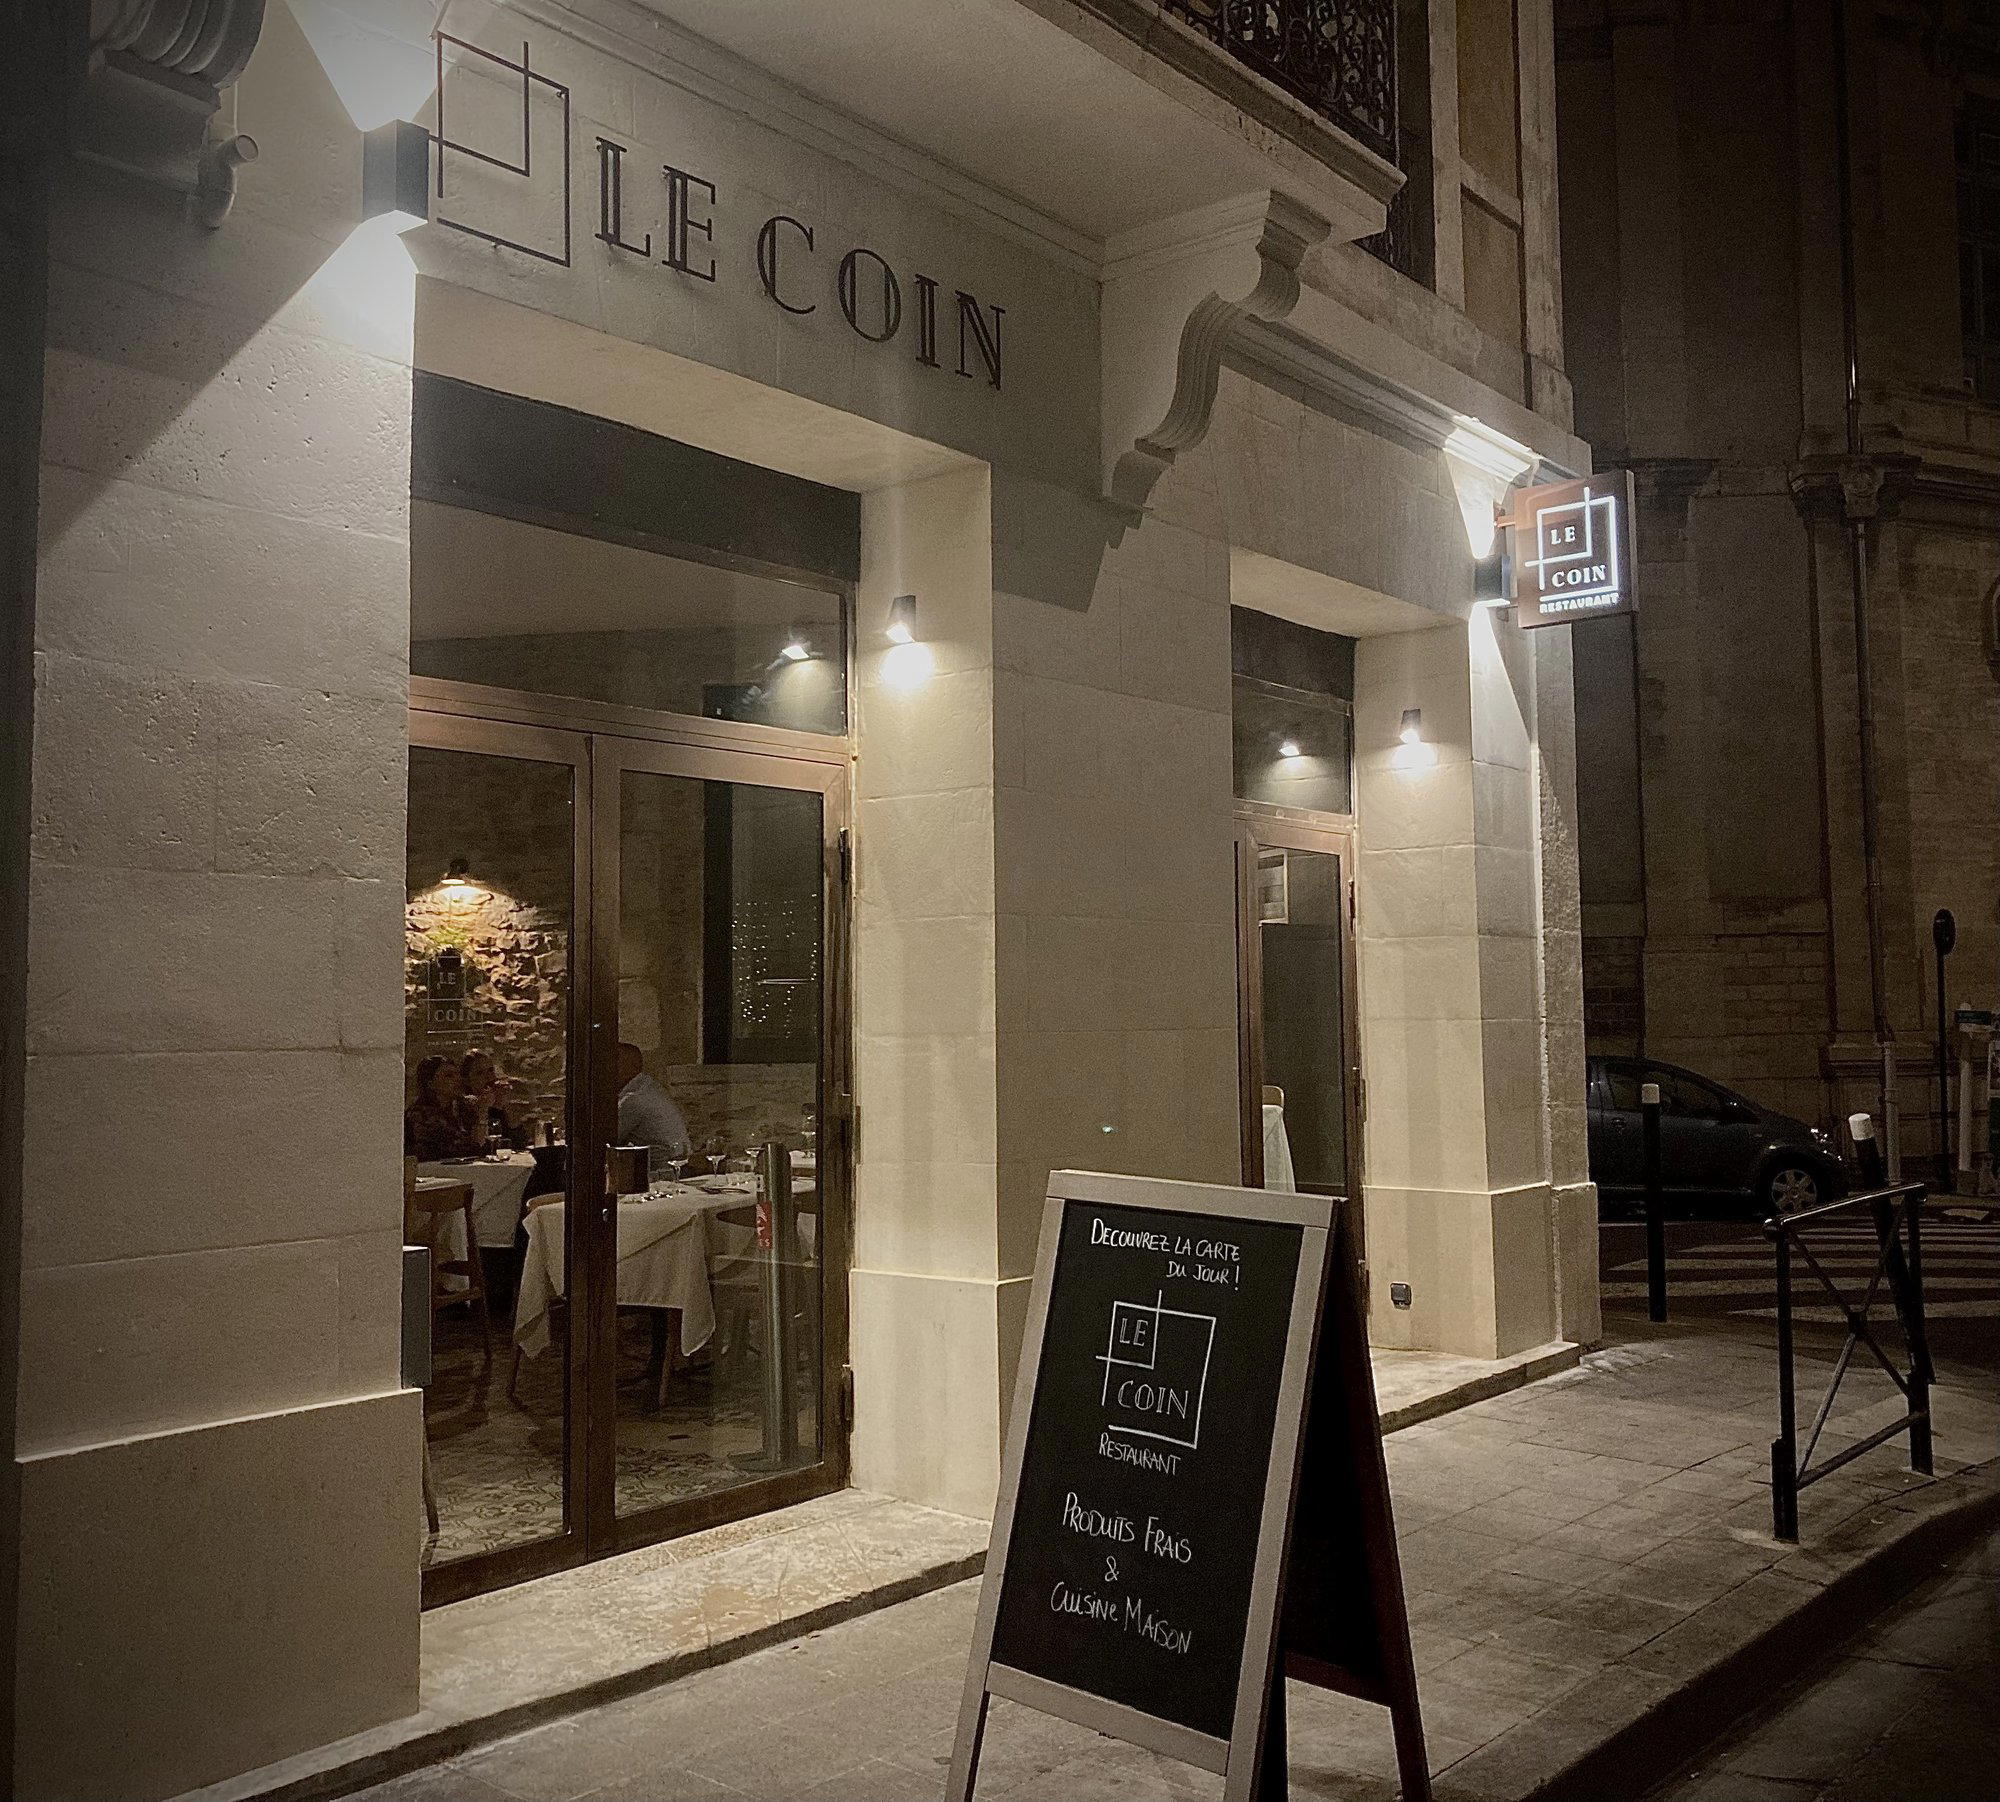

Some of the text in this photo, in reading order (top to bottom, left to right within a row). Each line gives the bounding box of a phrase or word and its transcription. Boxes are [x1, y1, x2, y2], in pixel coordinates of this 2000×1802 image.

[595, 136, 1006, 391] LE COIN
[1550, 526, 1576, 545] LE
[1551, 564, 1606, 588] COIN
[1539, 592, 1619, 614] RESTAURANT
[1091, 1218, 1240, 1262] DECOUVREZ LA CARTE
[1166, 1260, 1187, 1278] DU
[1119, 1317, 1149, 1347] LE
[1117, 1380, 1189, 1419] COIN
[1099, 1432, 1181, 1475] RESTAURANT
[1104, 1556, 1120, 1582] &
